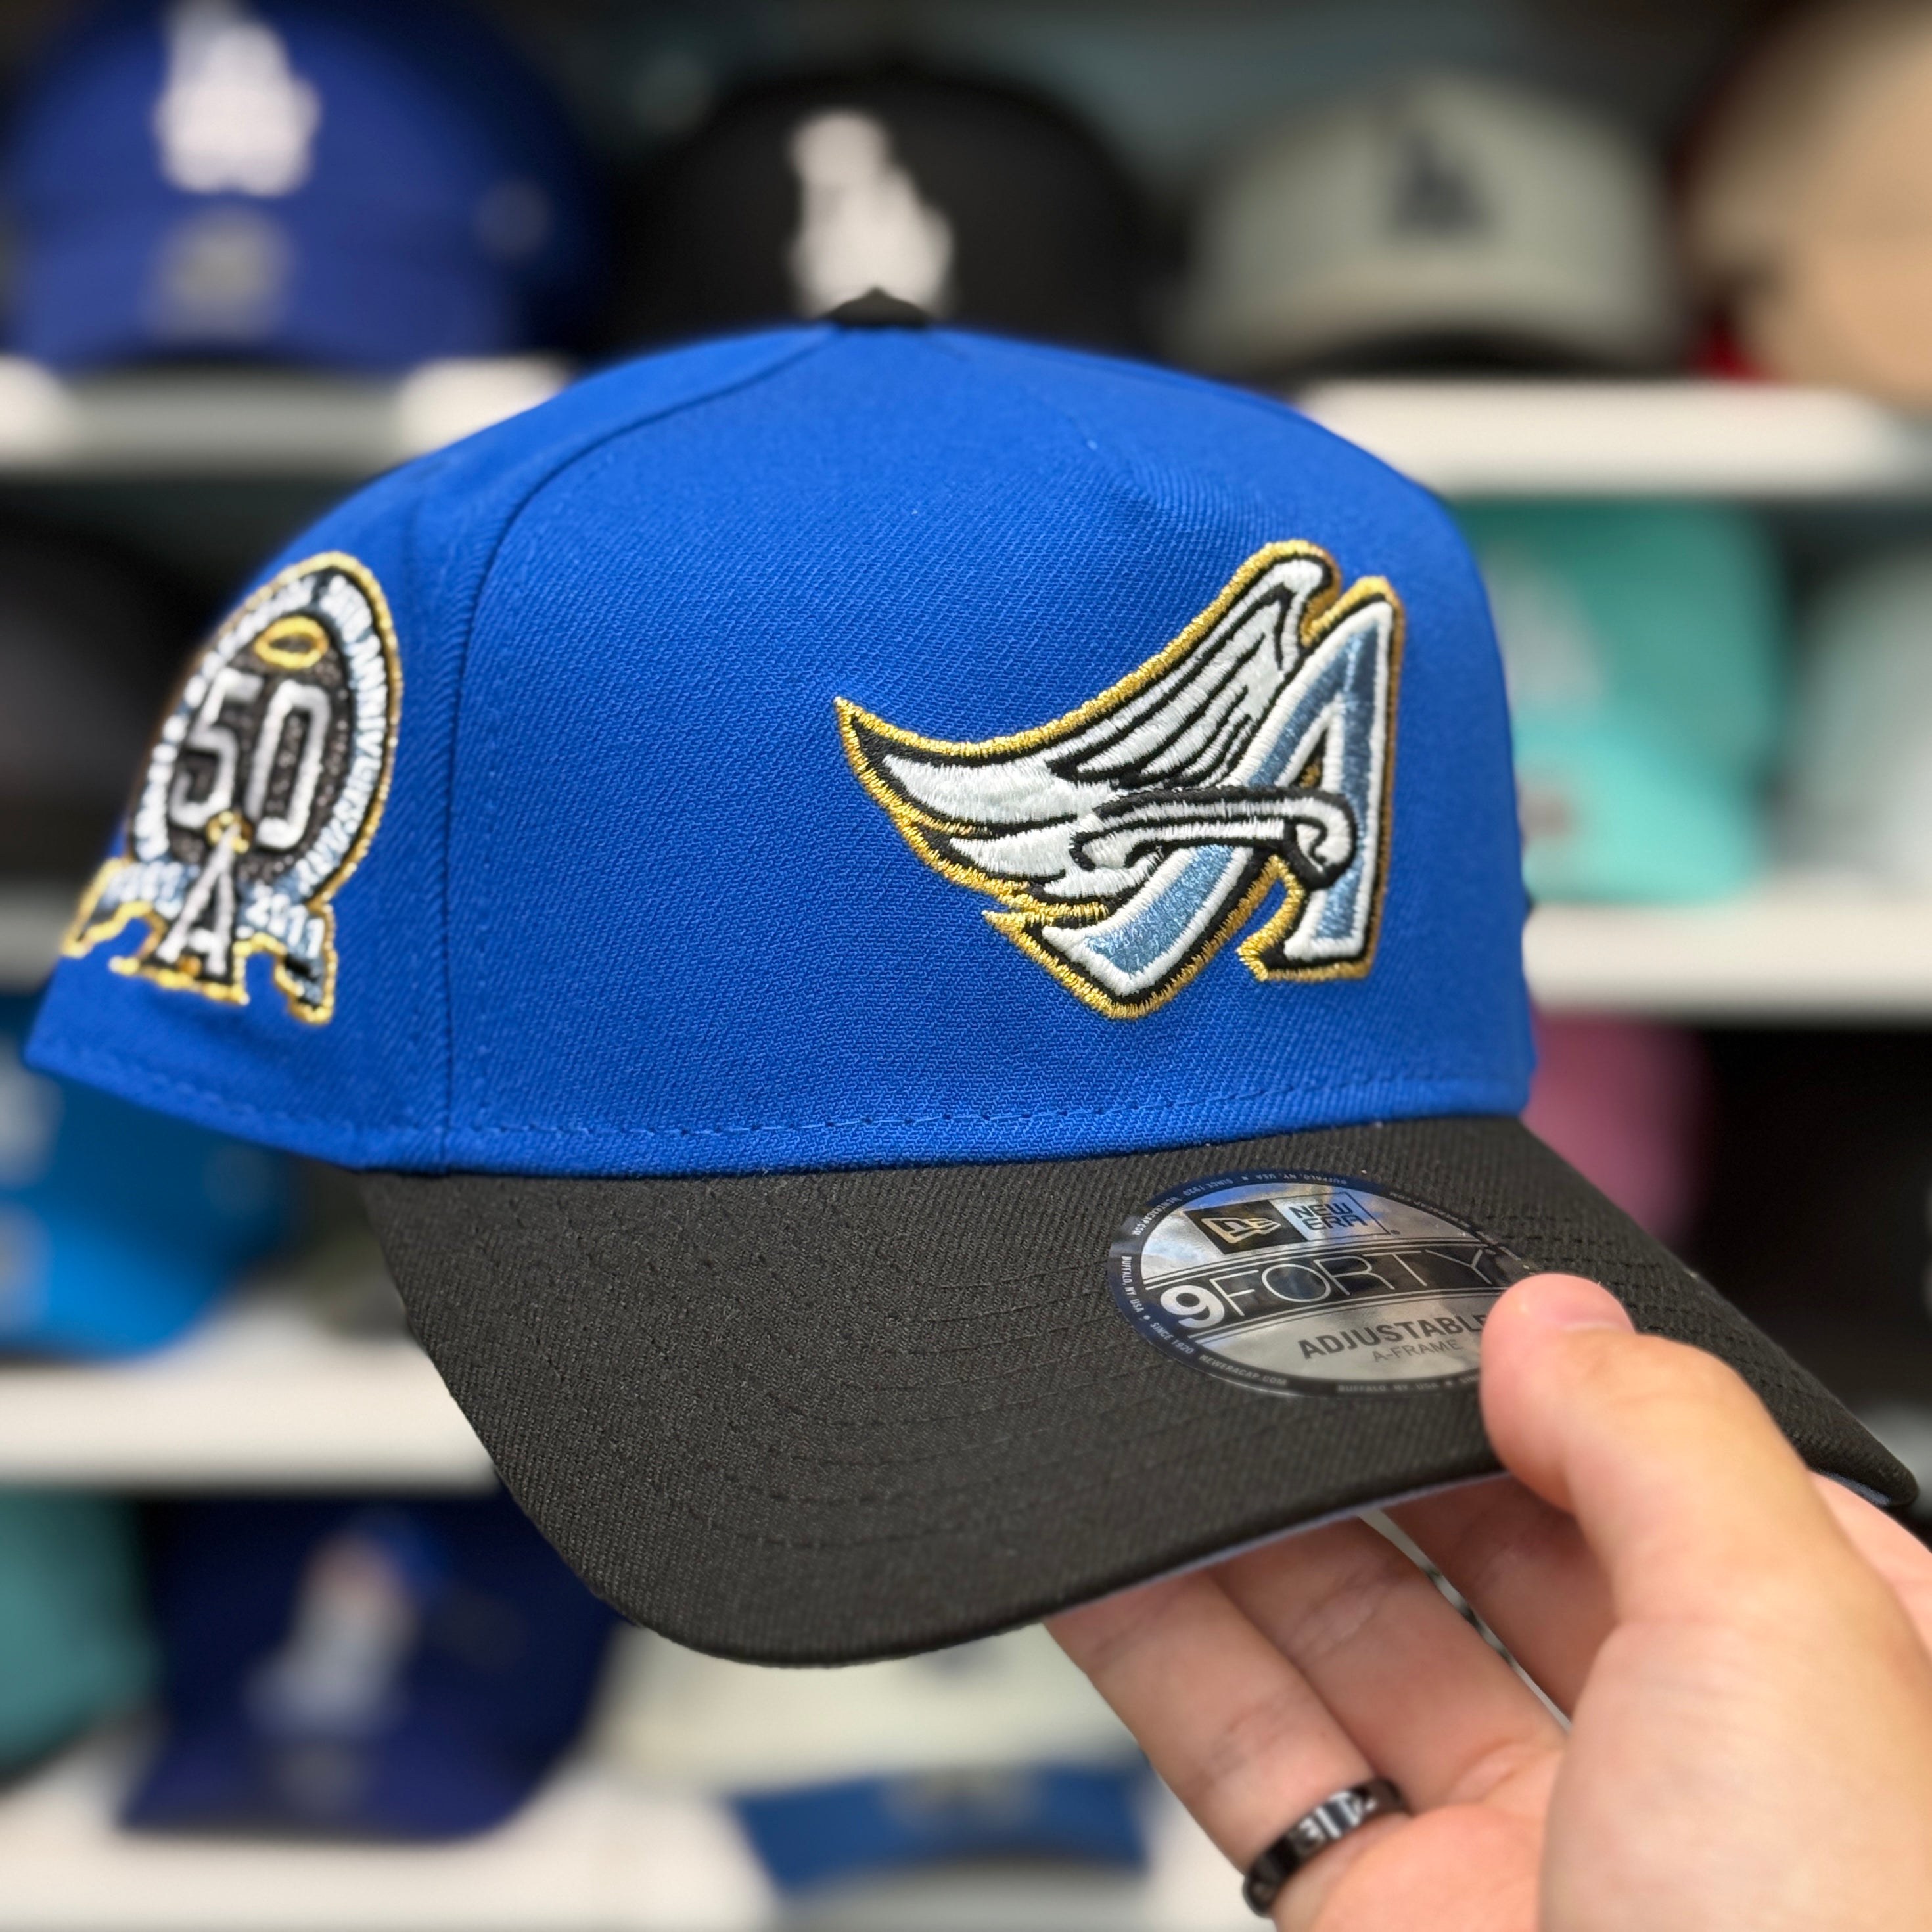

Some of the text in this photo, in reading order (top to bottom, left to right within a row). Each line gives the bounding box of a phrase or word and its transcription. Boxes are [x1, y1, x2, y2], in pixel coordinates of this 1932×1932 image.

[168, 666, 329, 849] 50
[1288, 1202, 1353, 1219] NEW
[1302, 1214, 1369, 1230] ERA
[1121, 1256, 1133, 1285] BUFFALO,
[1130, 1299, 1145, 1313] USA
[1160, 1249, 1493, 1329] 9FORTY
[1150, 1322, 1195, 1354] SINCE 1920
[1371, 1339, 1464, 1363] A-FRAME
